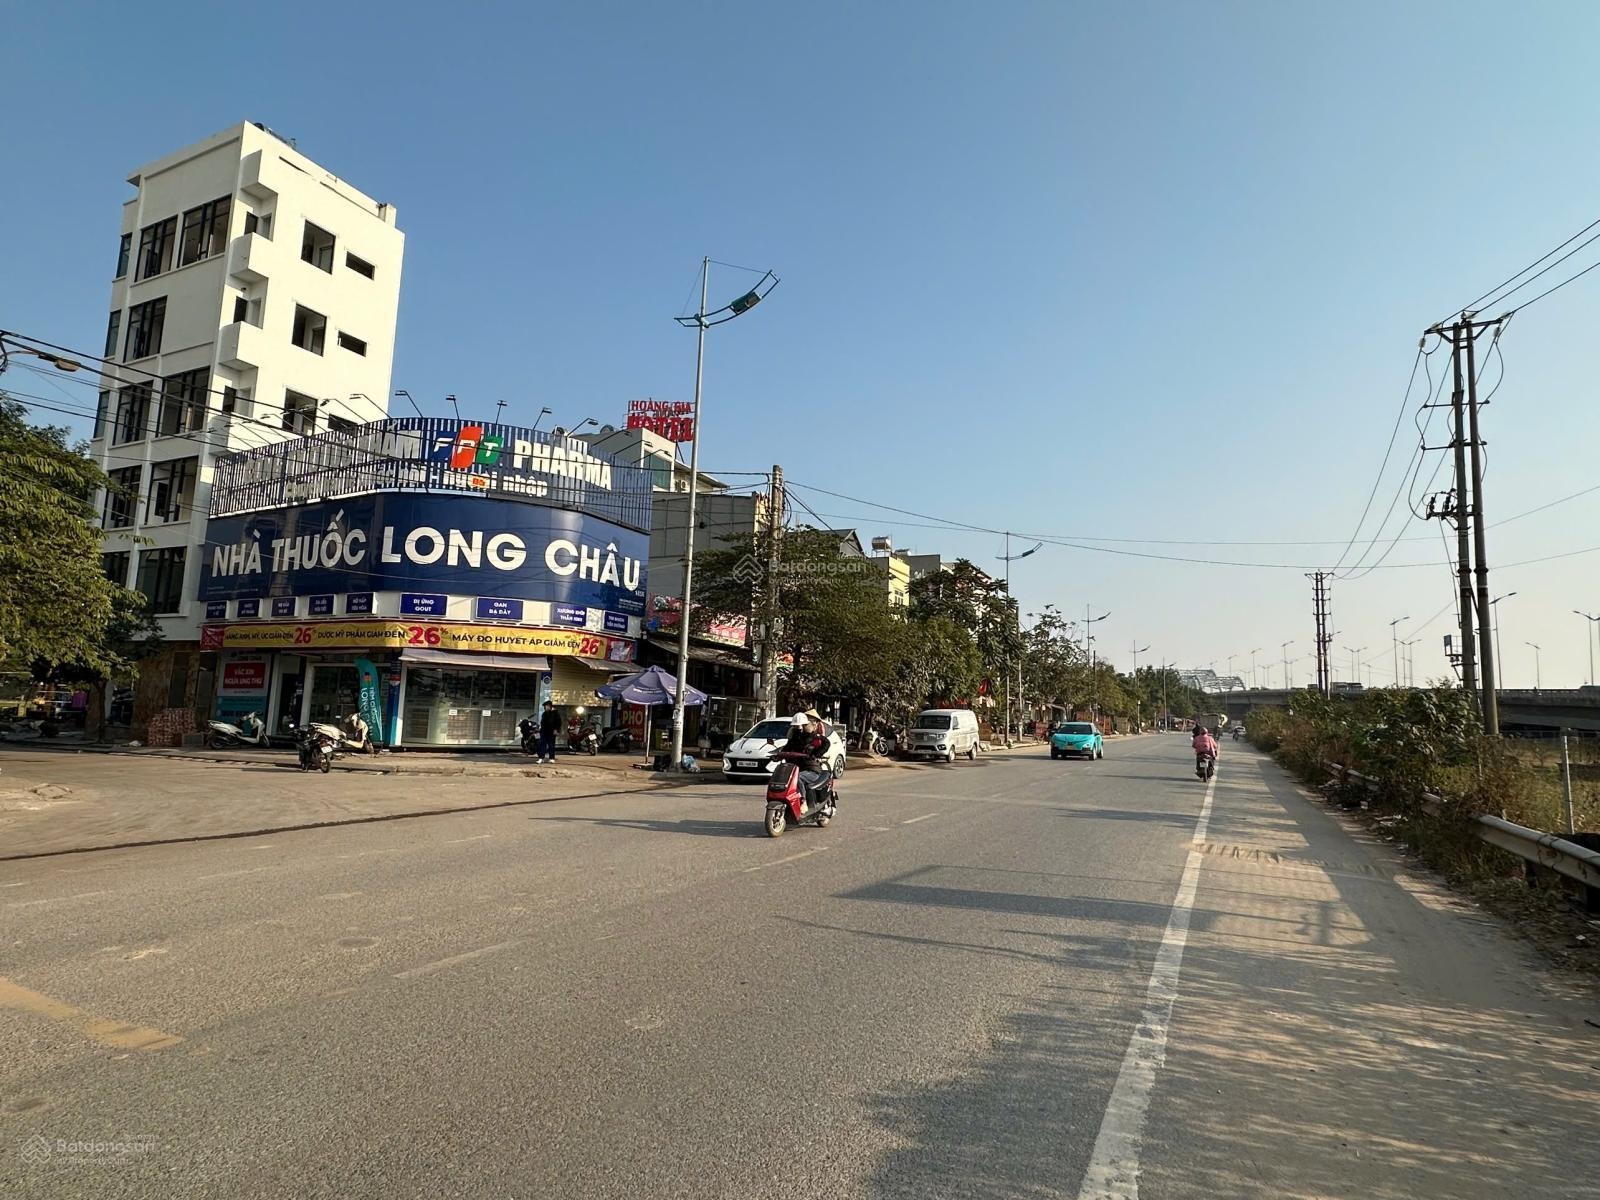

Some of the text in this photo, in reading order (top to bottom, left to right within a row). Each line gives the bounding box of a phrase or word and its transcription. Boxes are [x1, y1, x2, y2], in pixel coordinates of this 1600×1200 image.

[513, 438, 612, 492] PHARMA
[502, 474, 548, 498] nhập
[211, 508, 641, 592] NHÀ THUỐC LONG CHÂU
[452, 632, 475, 643] MÁY
[477, 634, 493, 644] ĐO
[543, 637, 566, 648] GIẢM
